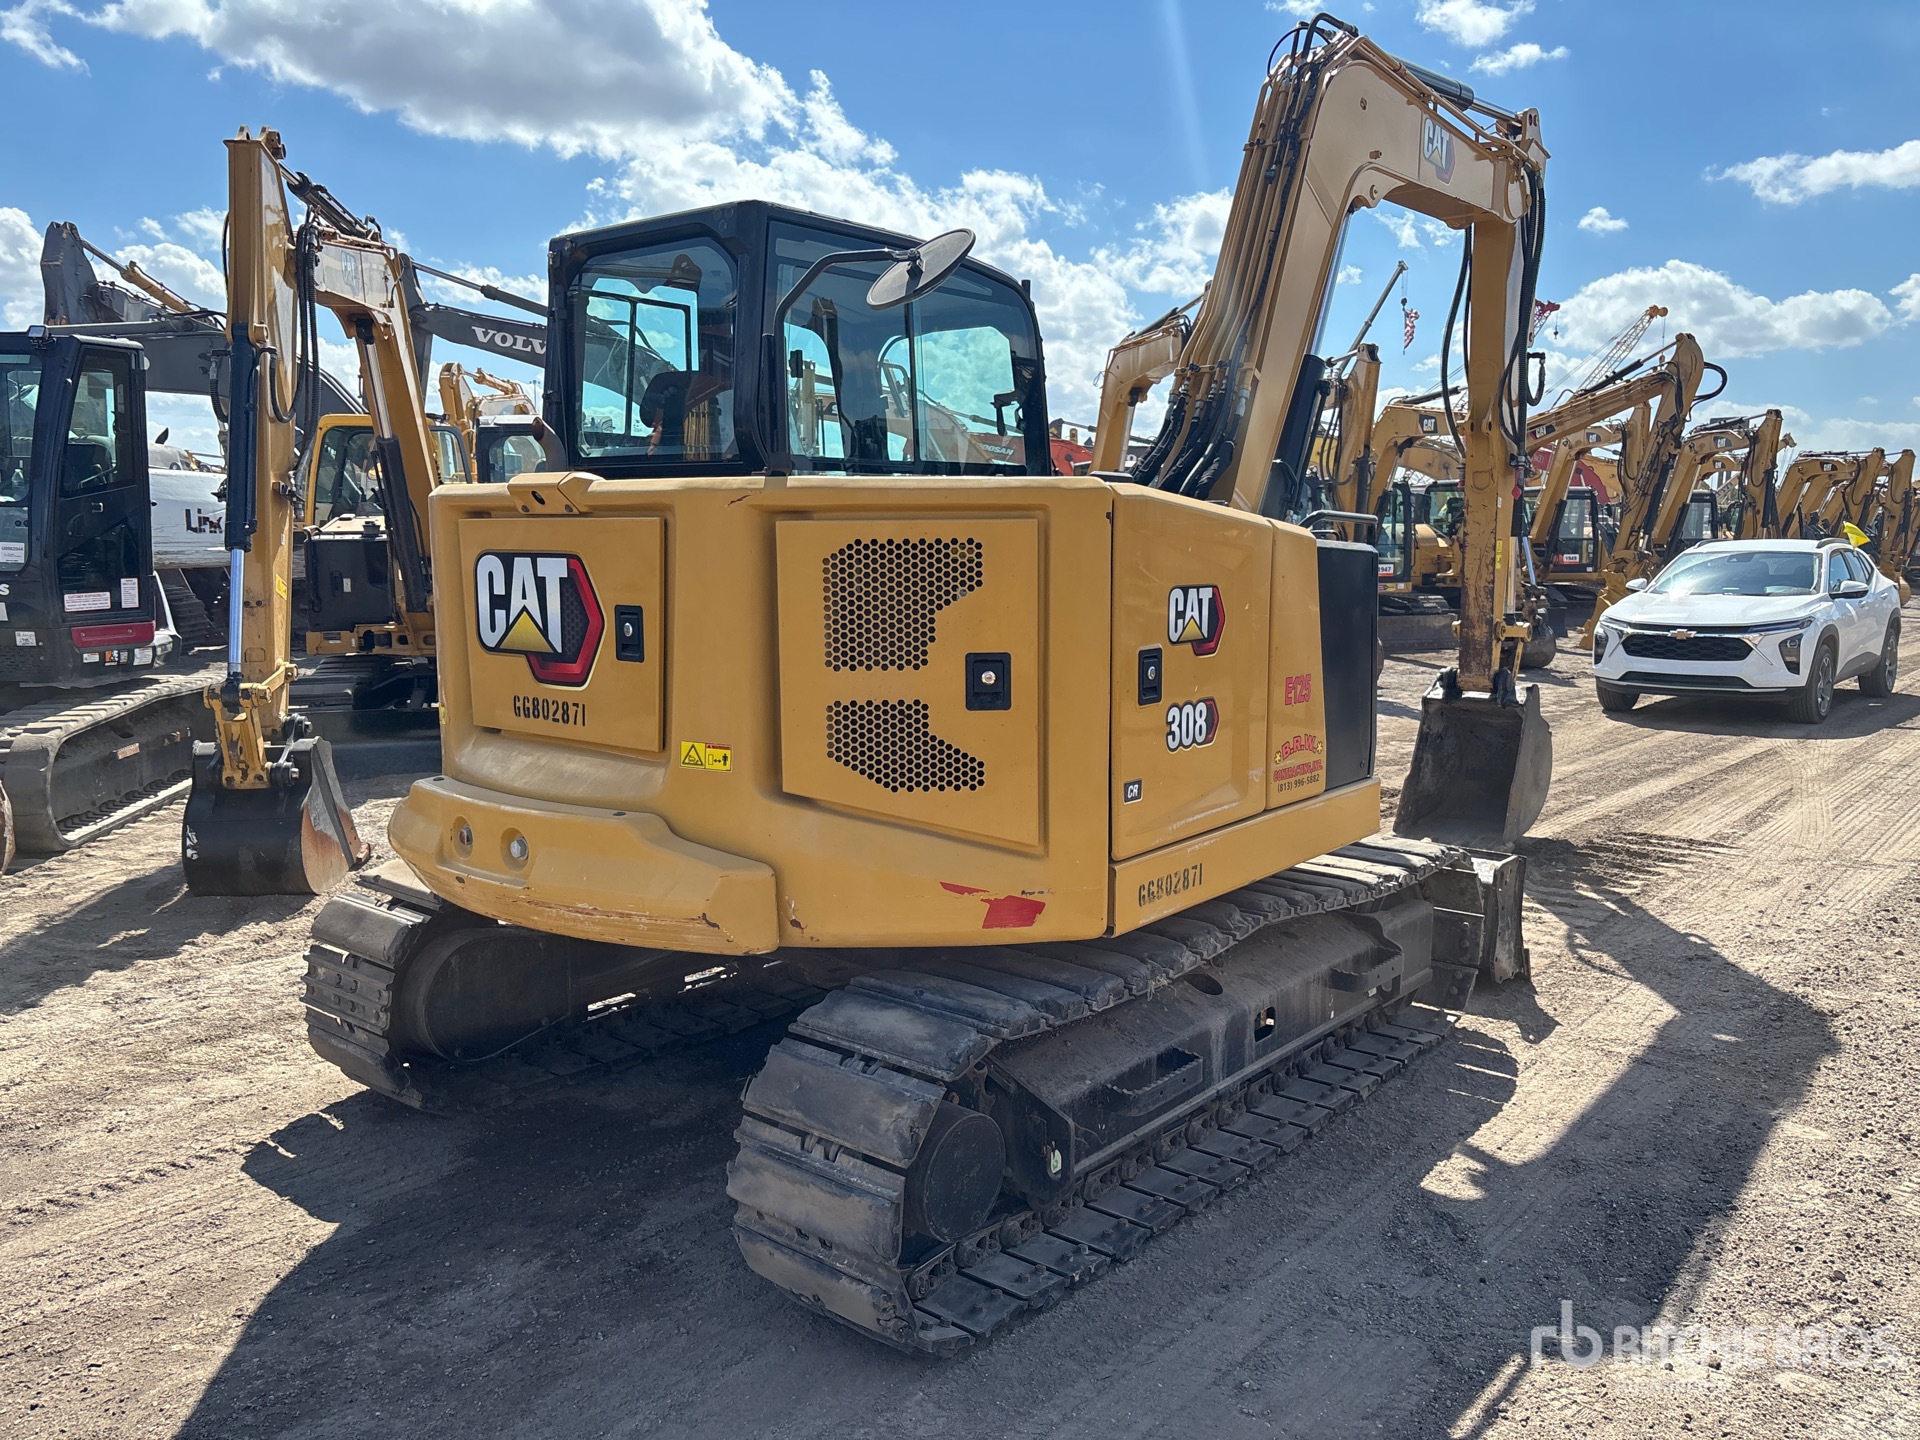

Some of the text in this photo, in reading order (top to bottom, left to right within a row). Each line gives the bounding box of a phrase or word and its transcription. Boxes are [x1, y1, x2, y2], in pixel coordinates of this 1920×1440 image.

[1424, 118, 1450, 170] CAT
[341, 250, 356, 285] CAT
[471, 325, 546, 355] VOLV
[1423, 418, 1436, 431] CAT
[1535, 426, 1547, 438] CAT
[979, 443, 1014, 456] OOSAN
[476, 554, 568, 653] CAT
[1169, 587, 1213, 643] CAT
[1285, 673, 1312, 705] E125
[513, 695, 586, 727] GG802871
[1167, 701, 1207, 750] 308
[1282, 733, 1317, 760] B.R.W.
[1127, 783, 1139, 799] CR
[1277, 773, 1320, 793] (813) 996-5882
